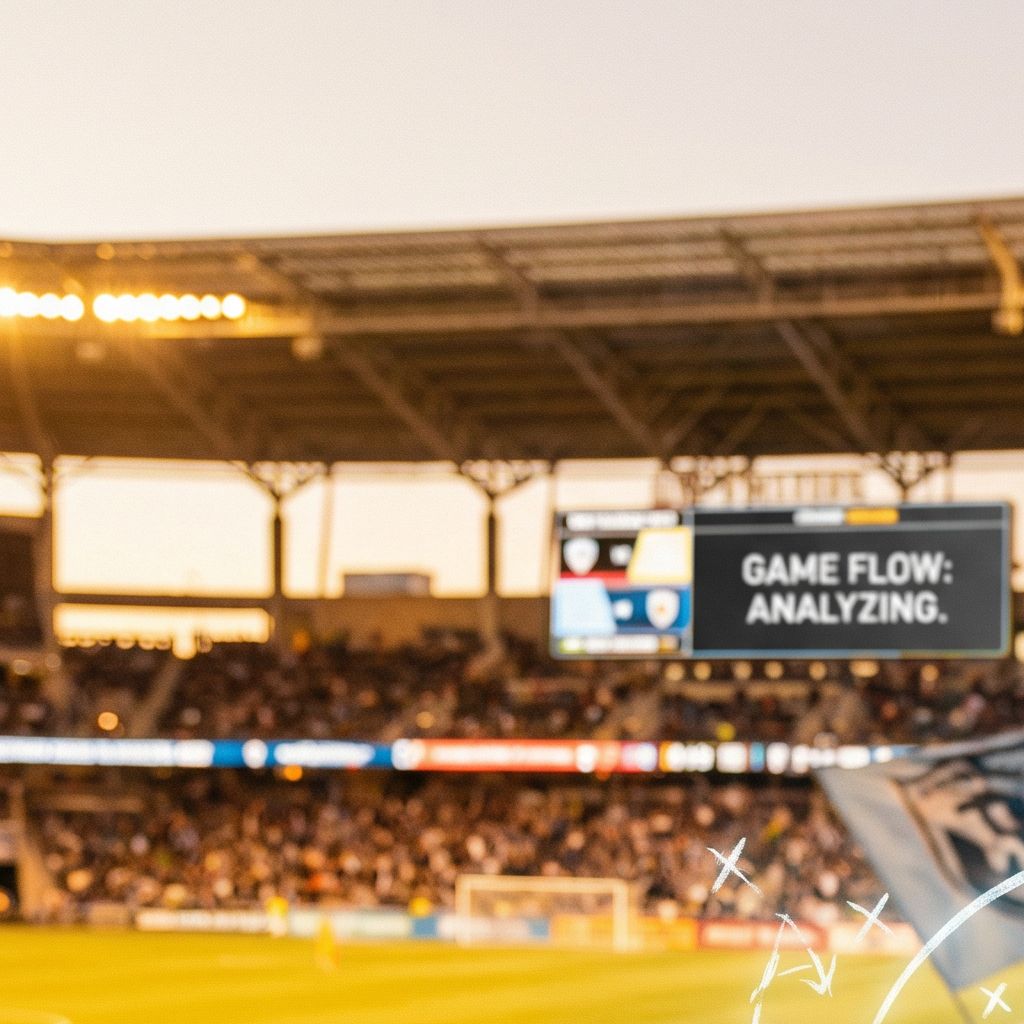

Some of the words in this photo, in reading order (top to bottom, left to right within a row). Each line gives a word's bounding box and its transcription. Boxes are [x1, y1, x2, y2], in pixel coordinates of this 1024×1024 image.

[741, 552, 840, 587] GAME
[846, 551, 954, 586] FLOW:
[745, 590, 949, 625] ANALYZING.
